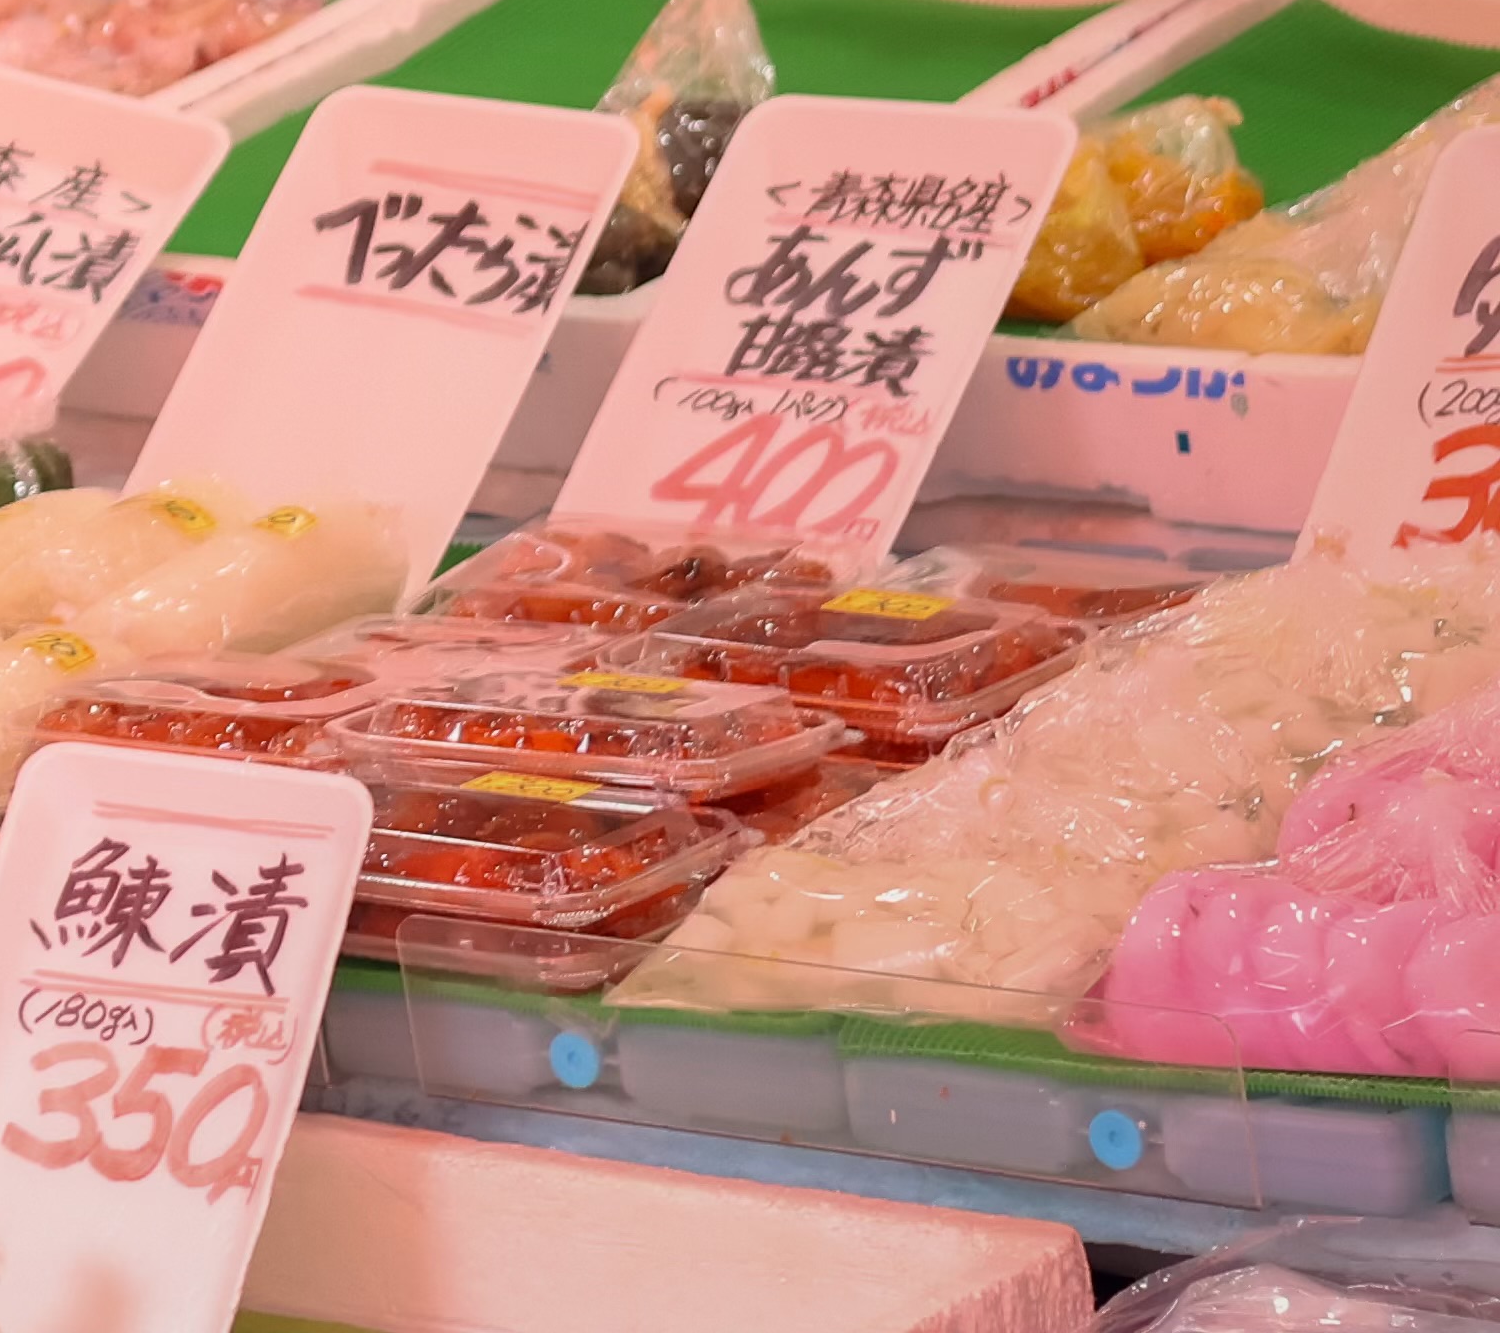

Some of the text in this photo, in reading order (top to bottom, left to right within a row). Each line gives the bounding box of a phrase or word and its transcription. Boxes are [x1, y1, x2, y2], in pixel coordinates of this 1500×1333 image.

[724, 225, 988, 321] あんず
[29, 837, 310, 997] 鰊漬
